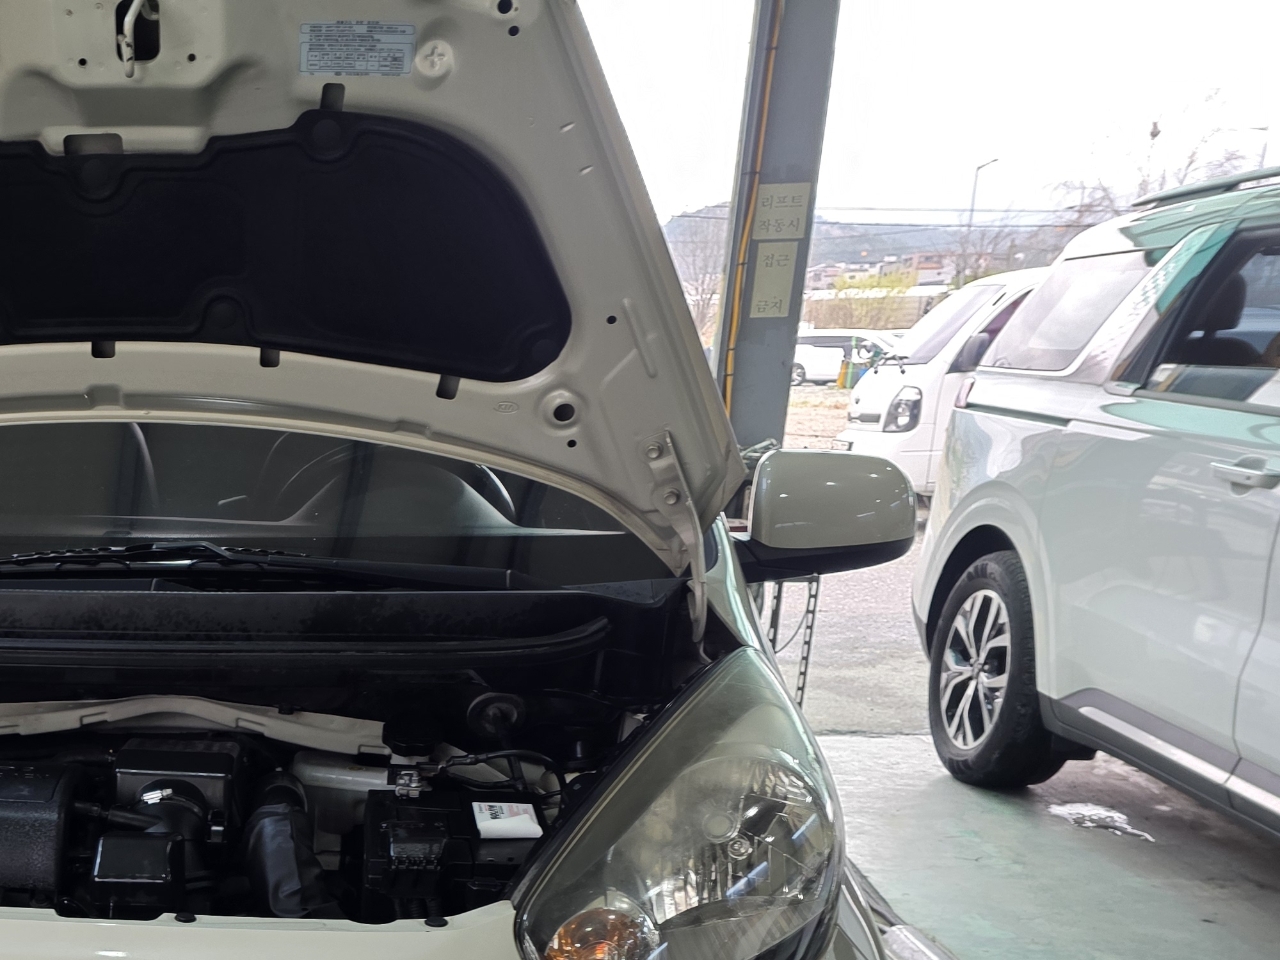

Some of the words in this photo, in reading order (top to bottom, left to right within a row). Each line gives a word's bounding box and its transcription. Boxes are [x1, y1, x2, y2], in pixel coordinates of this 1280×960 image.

[761, 195, 803, 210] 리프트
[758, 217, 801, 233] 작동시
[762, 253, 791, 268] 접근
[756, 299, 783, 314] 금지
